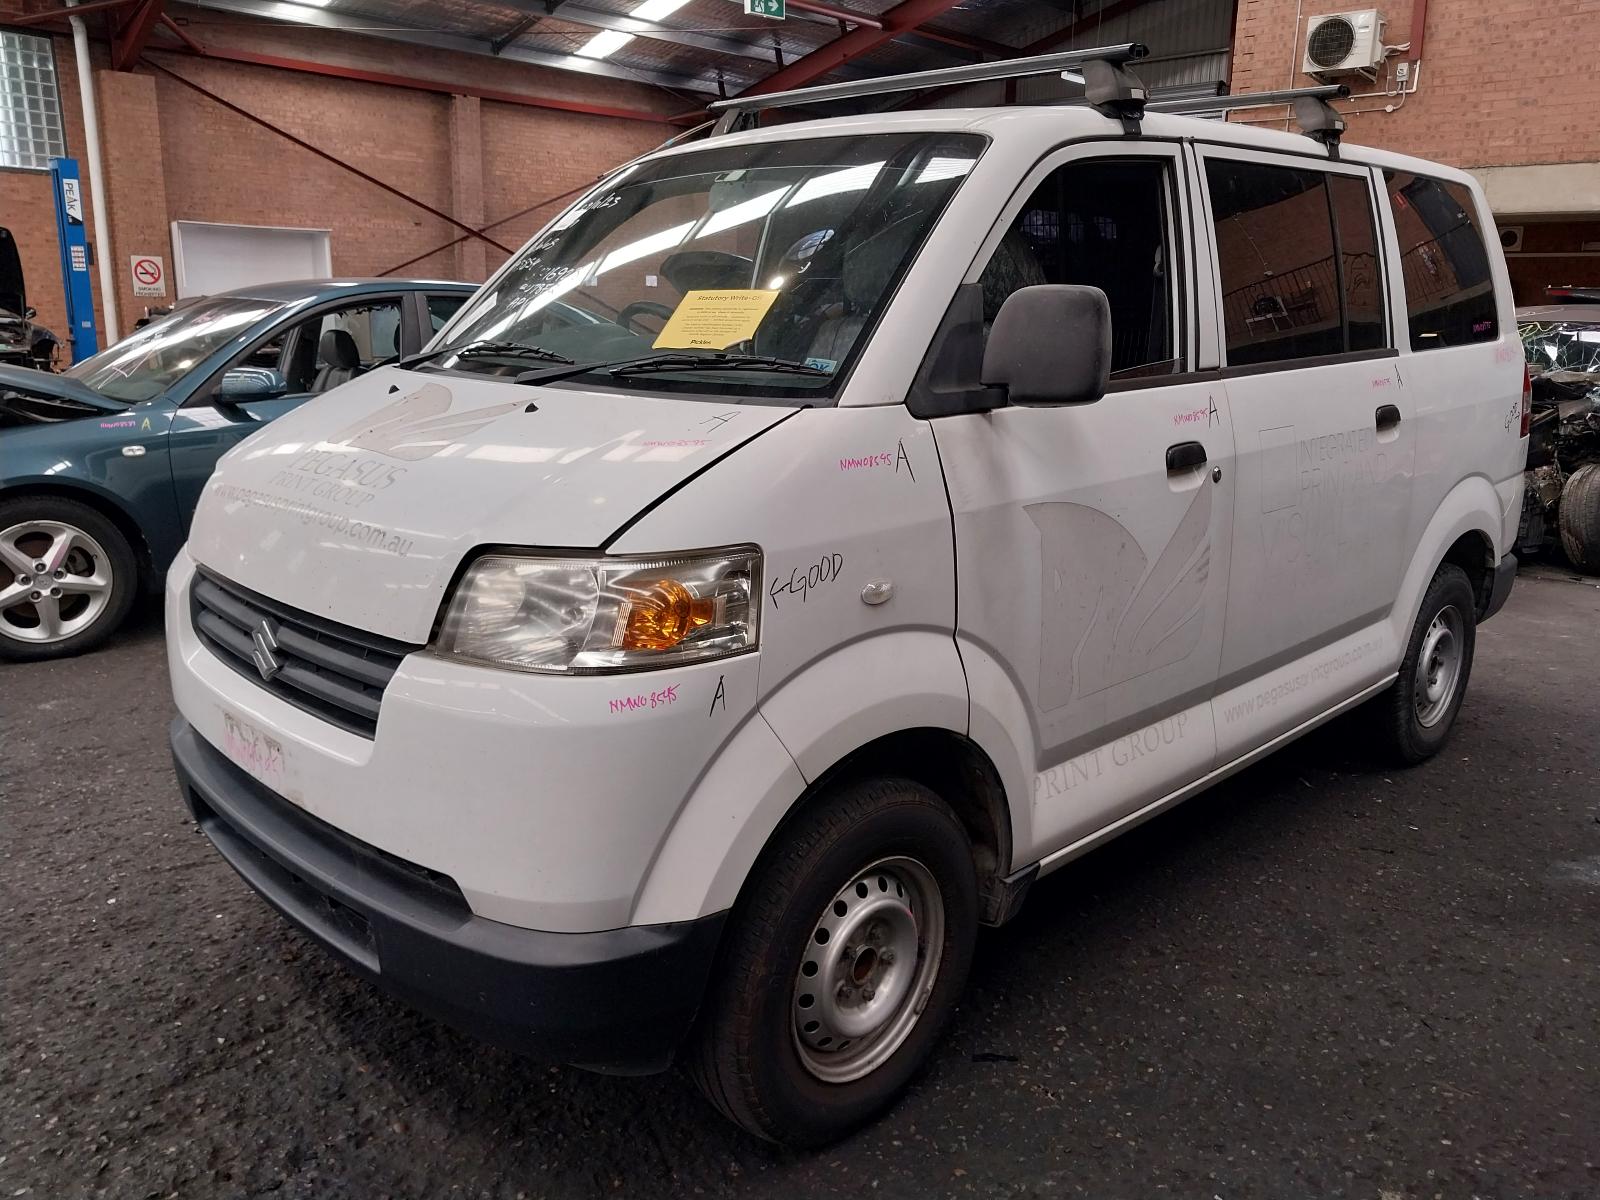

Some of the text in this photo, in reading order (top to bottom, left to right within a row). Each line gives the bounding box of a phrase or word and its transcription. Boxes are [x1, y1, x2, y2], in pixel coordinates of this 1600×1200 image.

[64, 182, 77, 211] PEAK
[141, 417, 152, 431] A
[1208, 394, 1220, 429] A
[289, 449, 408, 490] PEGASUS
[895, 437, 916, 483] A
[269, 471, 376, 508] PRINT GROUP
[789, 552, 843, 603] GOOD
[708, 674, 726, 718] A
[1032, 712, 1188, 806] PRINT GROUP
